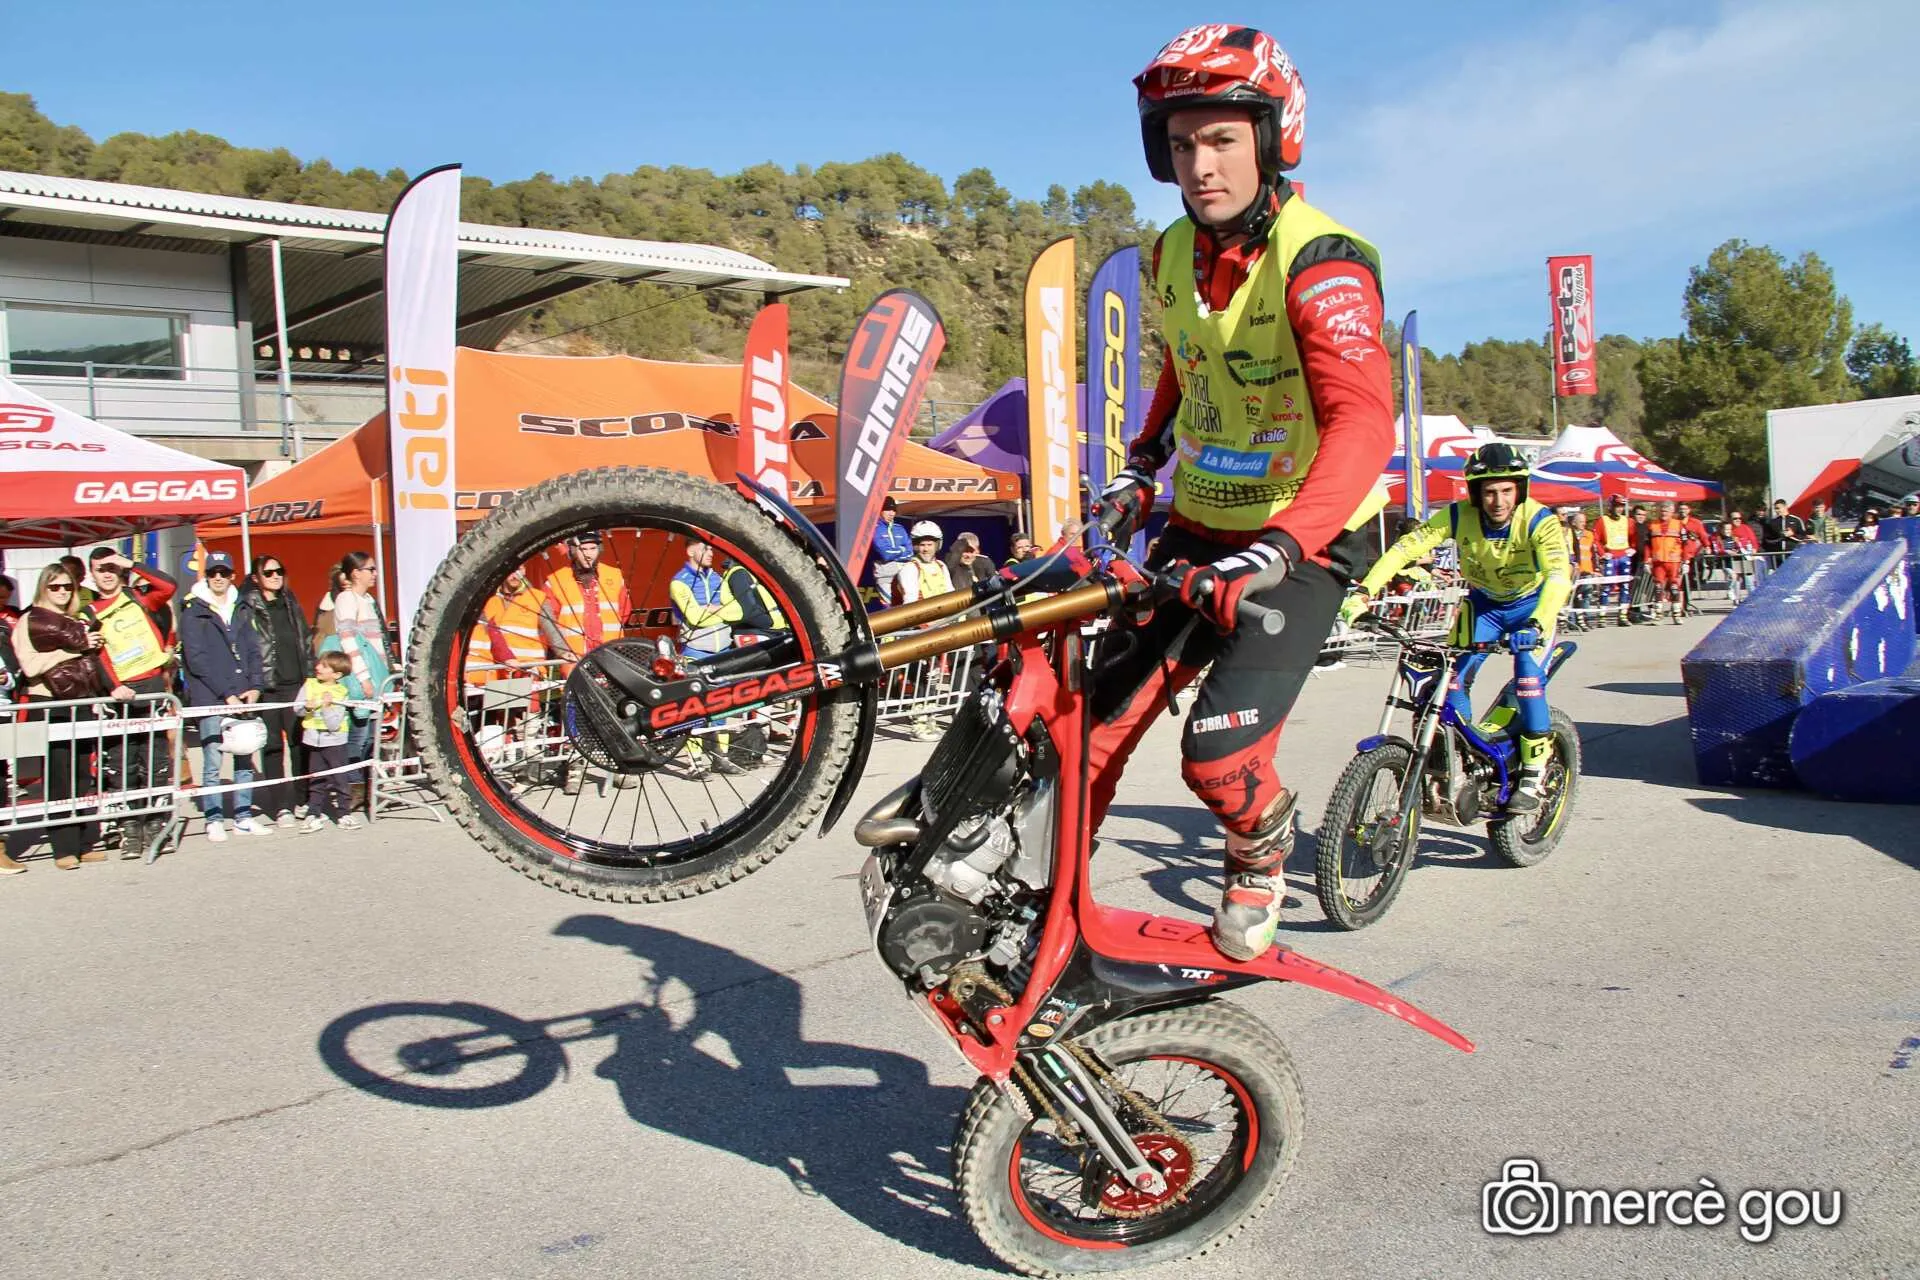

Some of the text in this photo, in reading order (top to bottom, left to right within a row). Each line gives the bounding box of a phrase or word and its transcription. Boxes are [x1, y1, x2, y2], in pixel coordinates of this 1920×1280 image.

[1164, 86, 1206, 98] GASGAS
[1558, 266, 1577, 363] Beta
[845, 305, 933, 497] COMAS
[1104, 290, 1126, 486] ERCO
[393, 365, 449, 510] iati
[519, 412, 831, 439] SCORA
[752, 350, 789, 522] OTUL
[1040, 287, 1069, 543] CORPA
[1202, 452, 1218, 467] La
[74, 479, 238, 504] GASGAS
[889, 477, 998, 493] CORPA
[650, 663, 815, 729] GASGAS
[1192, 756, 1261, 789] ASGAS
[1181, 968, 1214, 981] TXT
